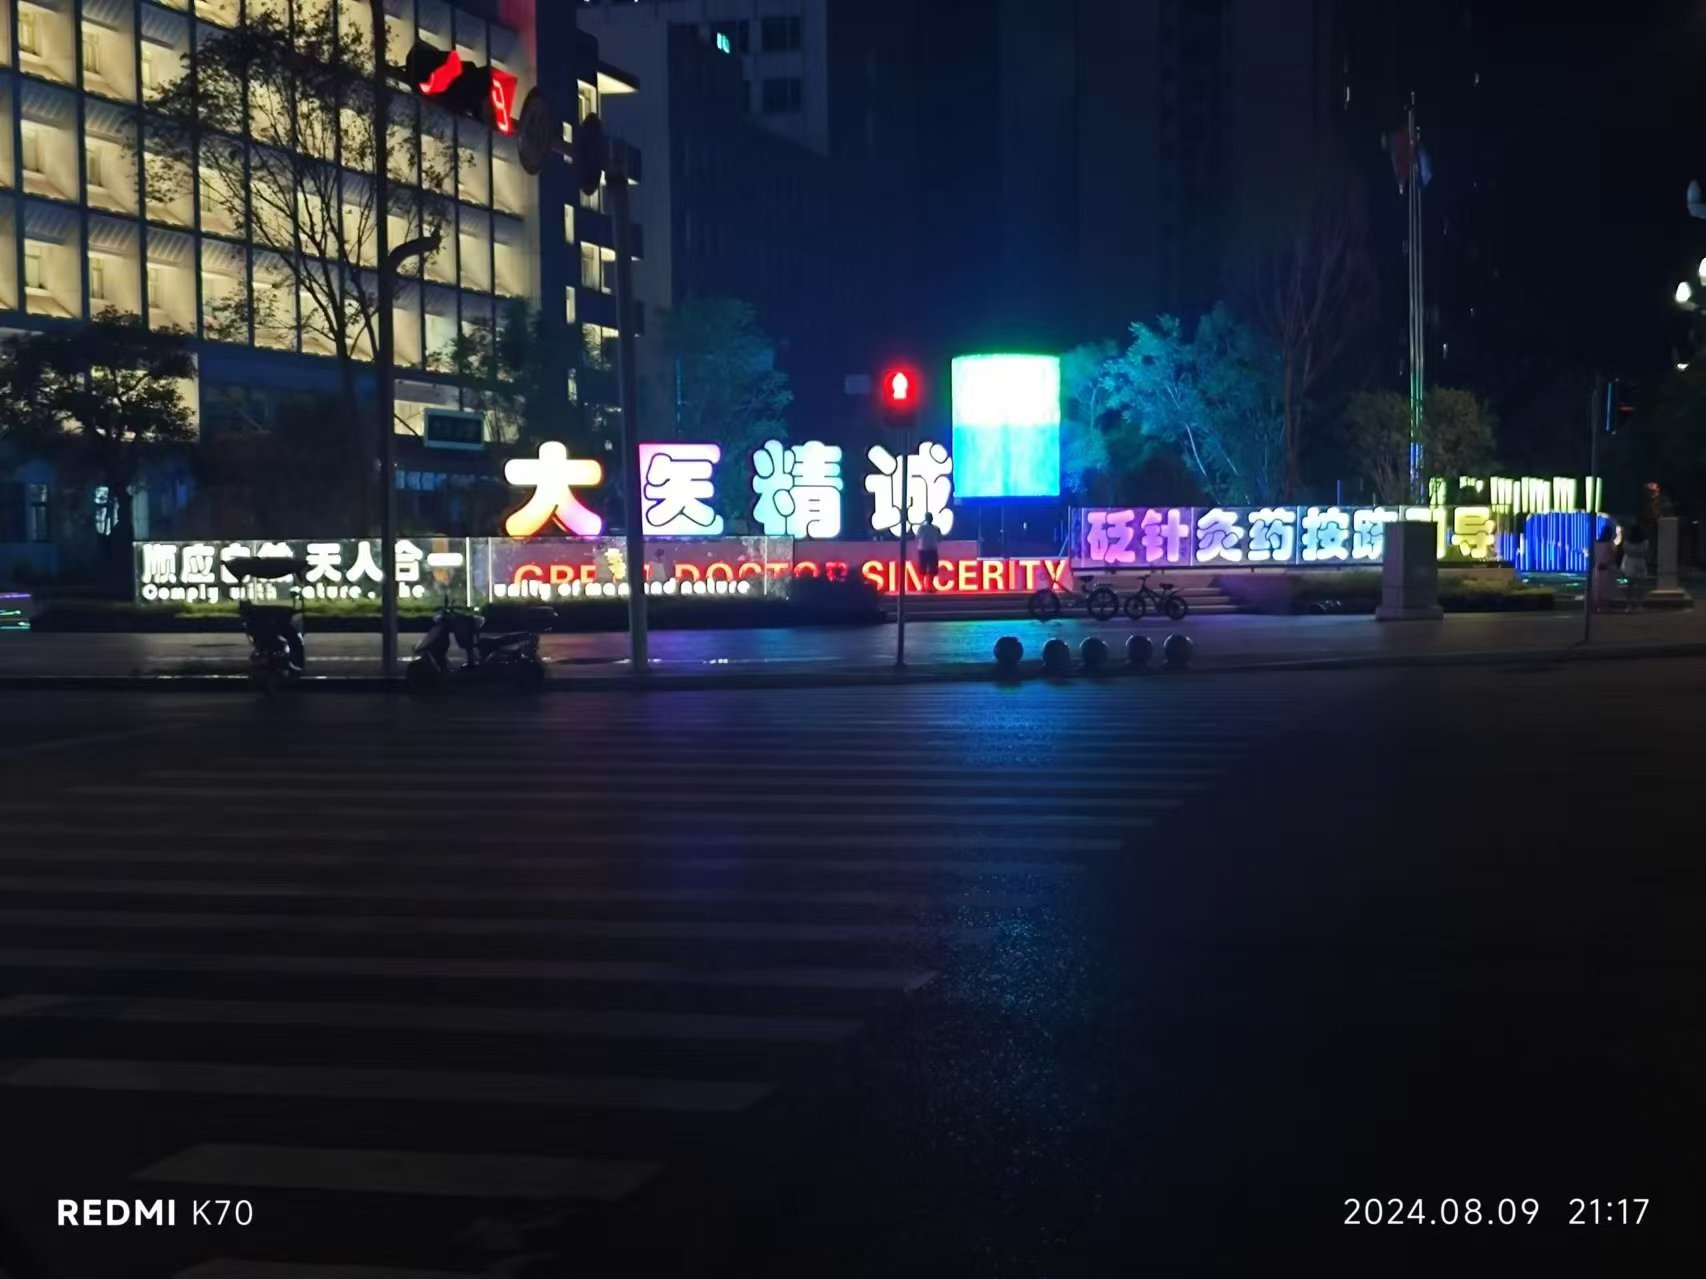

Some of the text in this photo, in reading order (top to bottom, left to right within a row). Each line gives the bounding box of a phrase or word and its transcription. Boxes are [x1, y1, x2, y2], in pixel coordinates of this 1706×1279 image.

[505, 440, 954, 540] 大医精诚
[305, 539, 464, 583] 天人合一
[861, 559, 1066, 592] SINCERITY
[142, 583, 219, 604] Comply
[494, 579, 551, 602] unity
[558, 578, 581, 597] of
[680, 577, 750, 595] nature
